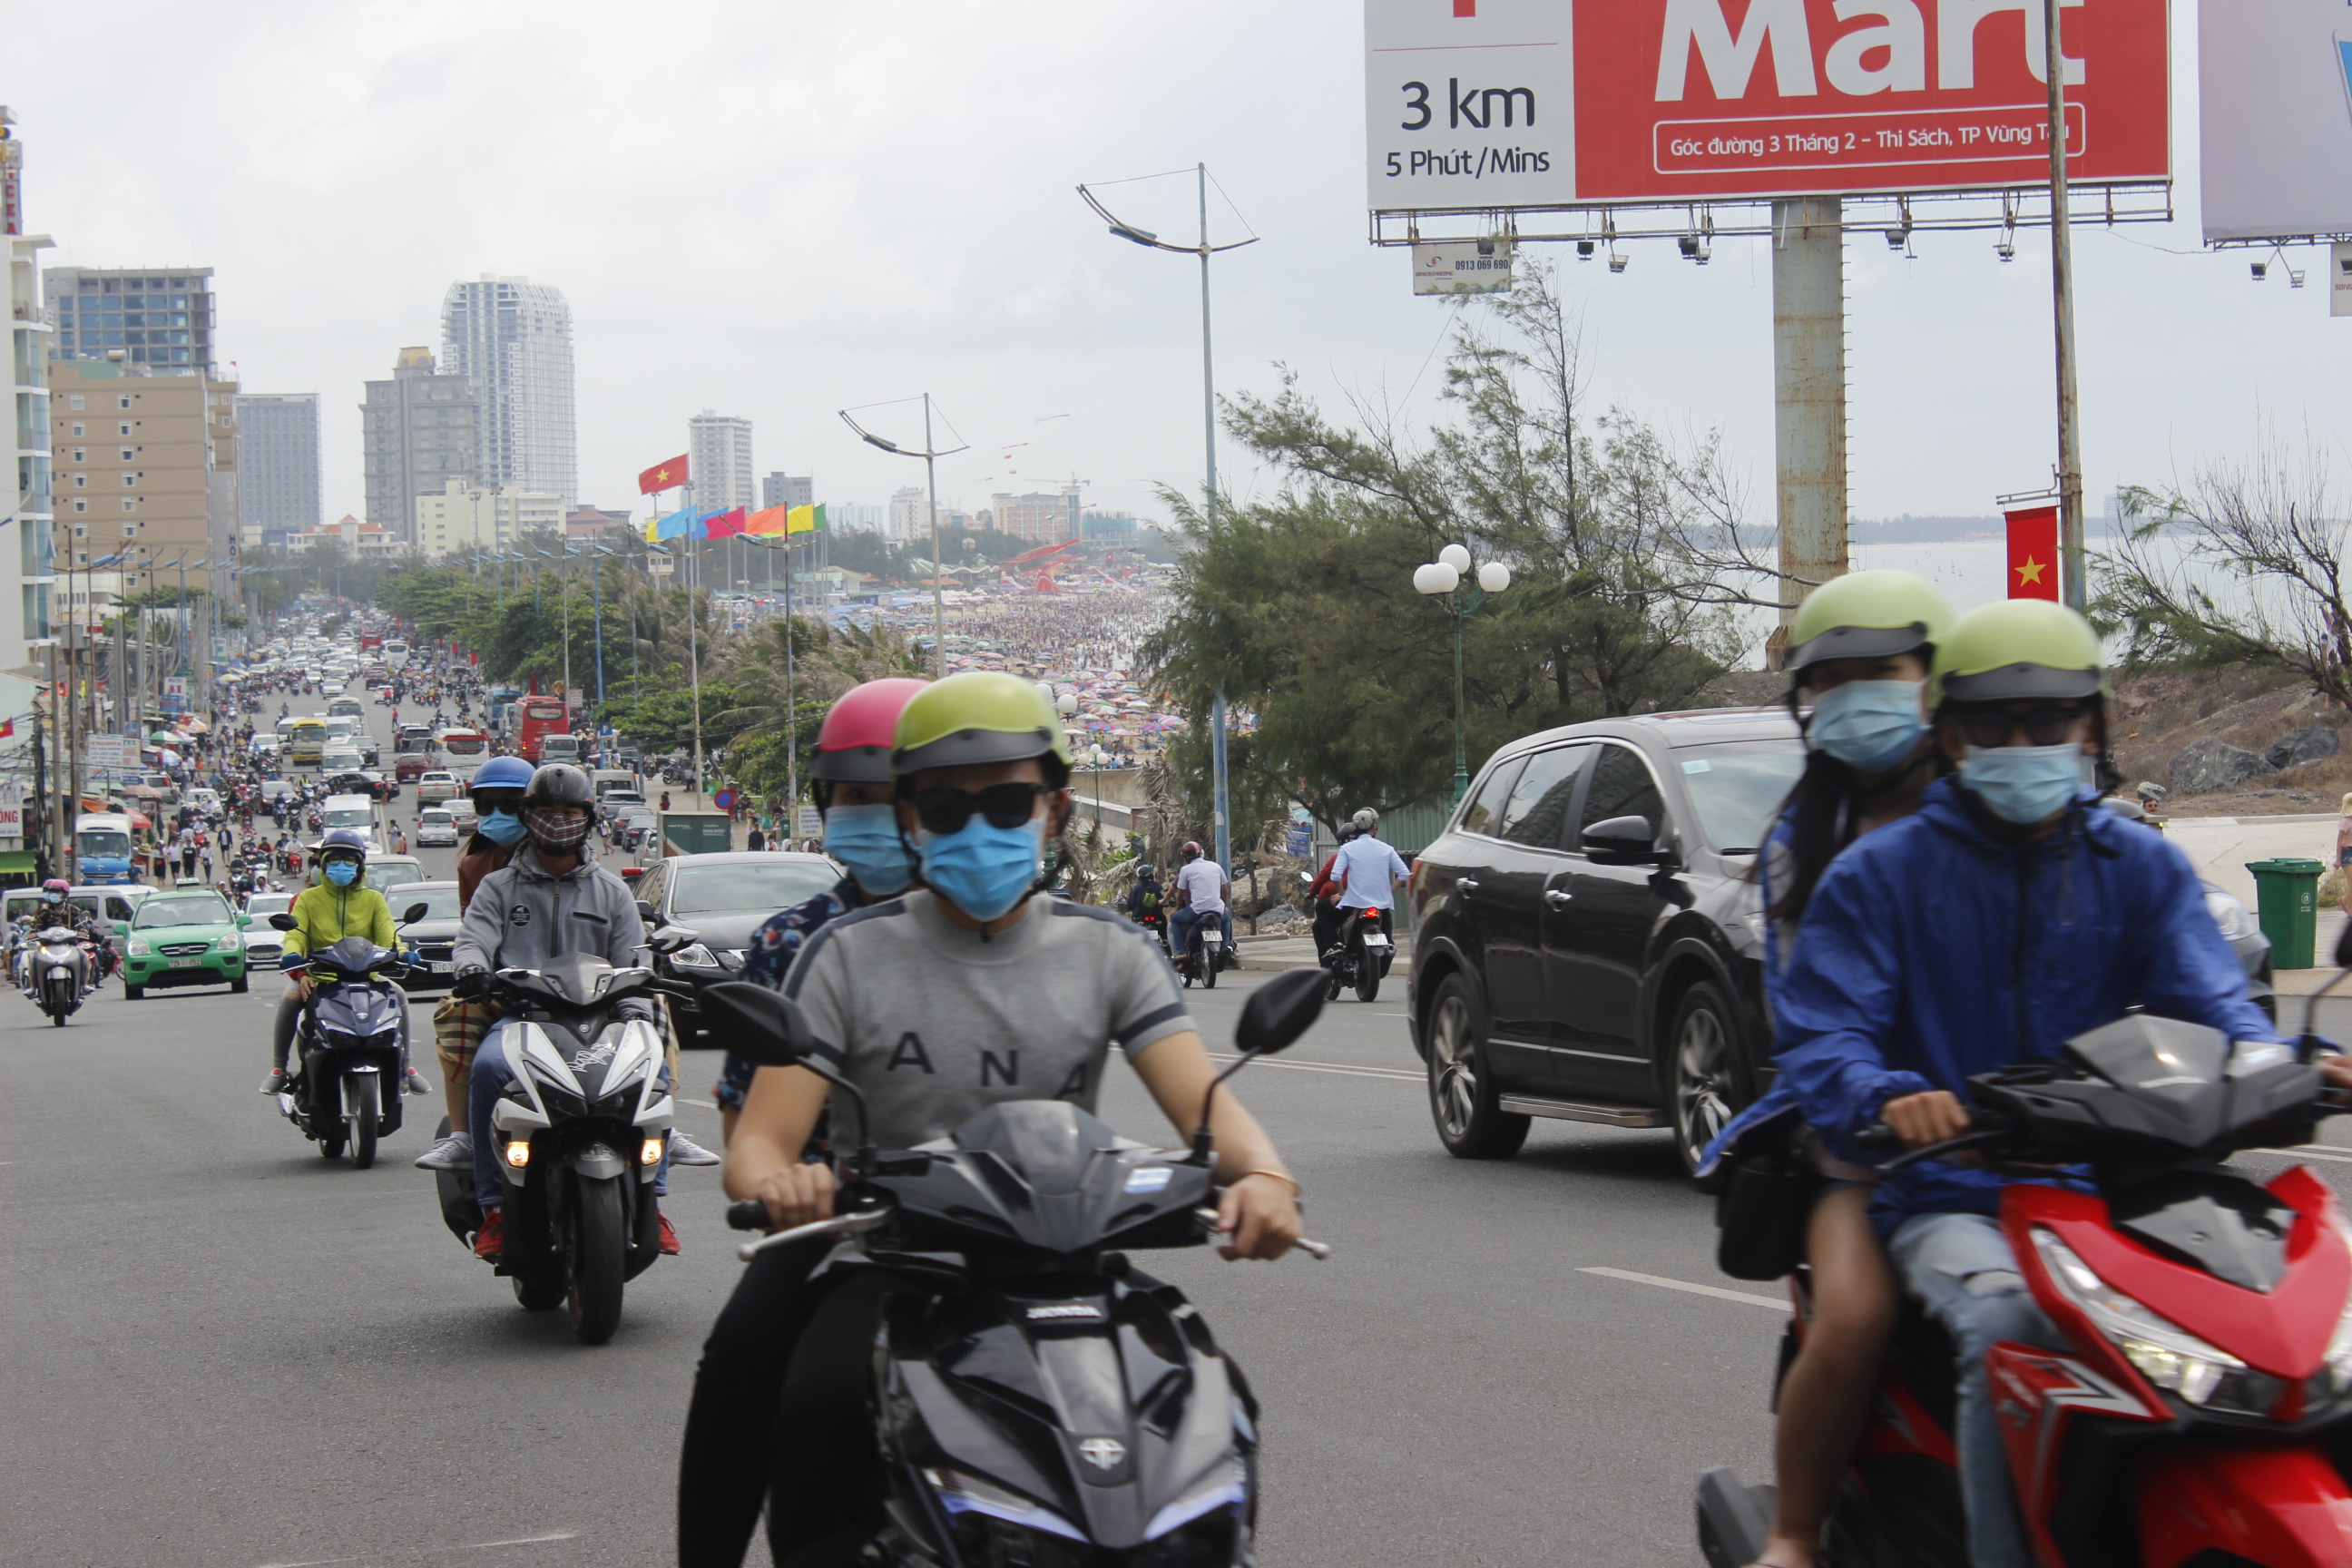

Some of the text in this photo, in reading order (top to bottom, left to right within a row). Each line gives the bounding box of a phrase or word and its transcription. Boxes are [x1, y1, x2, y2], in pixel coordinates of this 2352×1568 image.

[1401, 77, 1535, 131] 3 km
[1671, 139, 1703, 156] Góc
[1708, 136, 1763, 157] đường
[1769, 135, 1780, 152] 3
[1785, 133, 1839, 154] Tháng
[1845, 132, 1856, 150] 2
[1876, 130, 1903, 148] Thi
[1907, 128, 1953, 147] Sách,
[1958, 126, 1980, 144] TP
[1985, 124, 2032, 144] Vũng
[1387, 152, 1402, 177] 5
[1455, 260, 1508, 270] 0913 069 690
